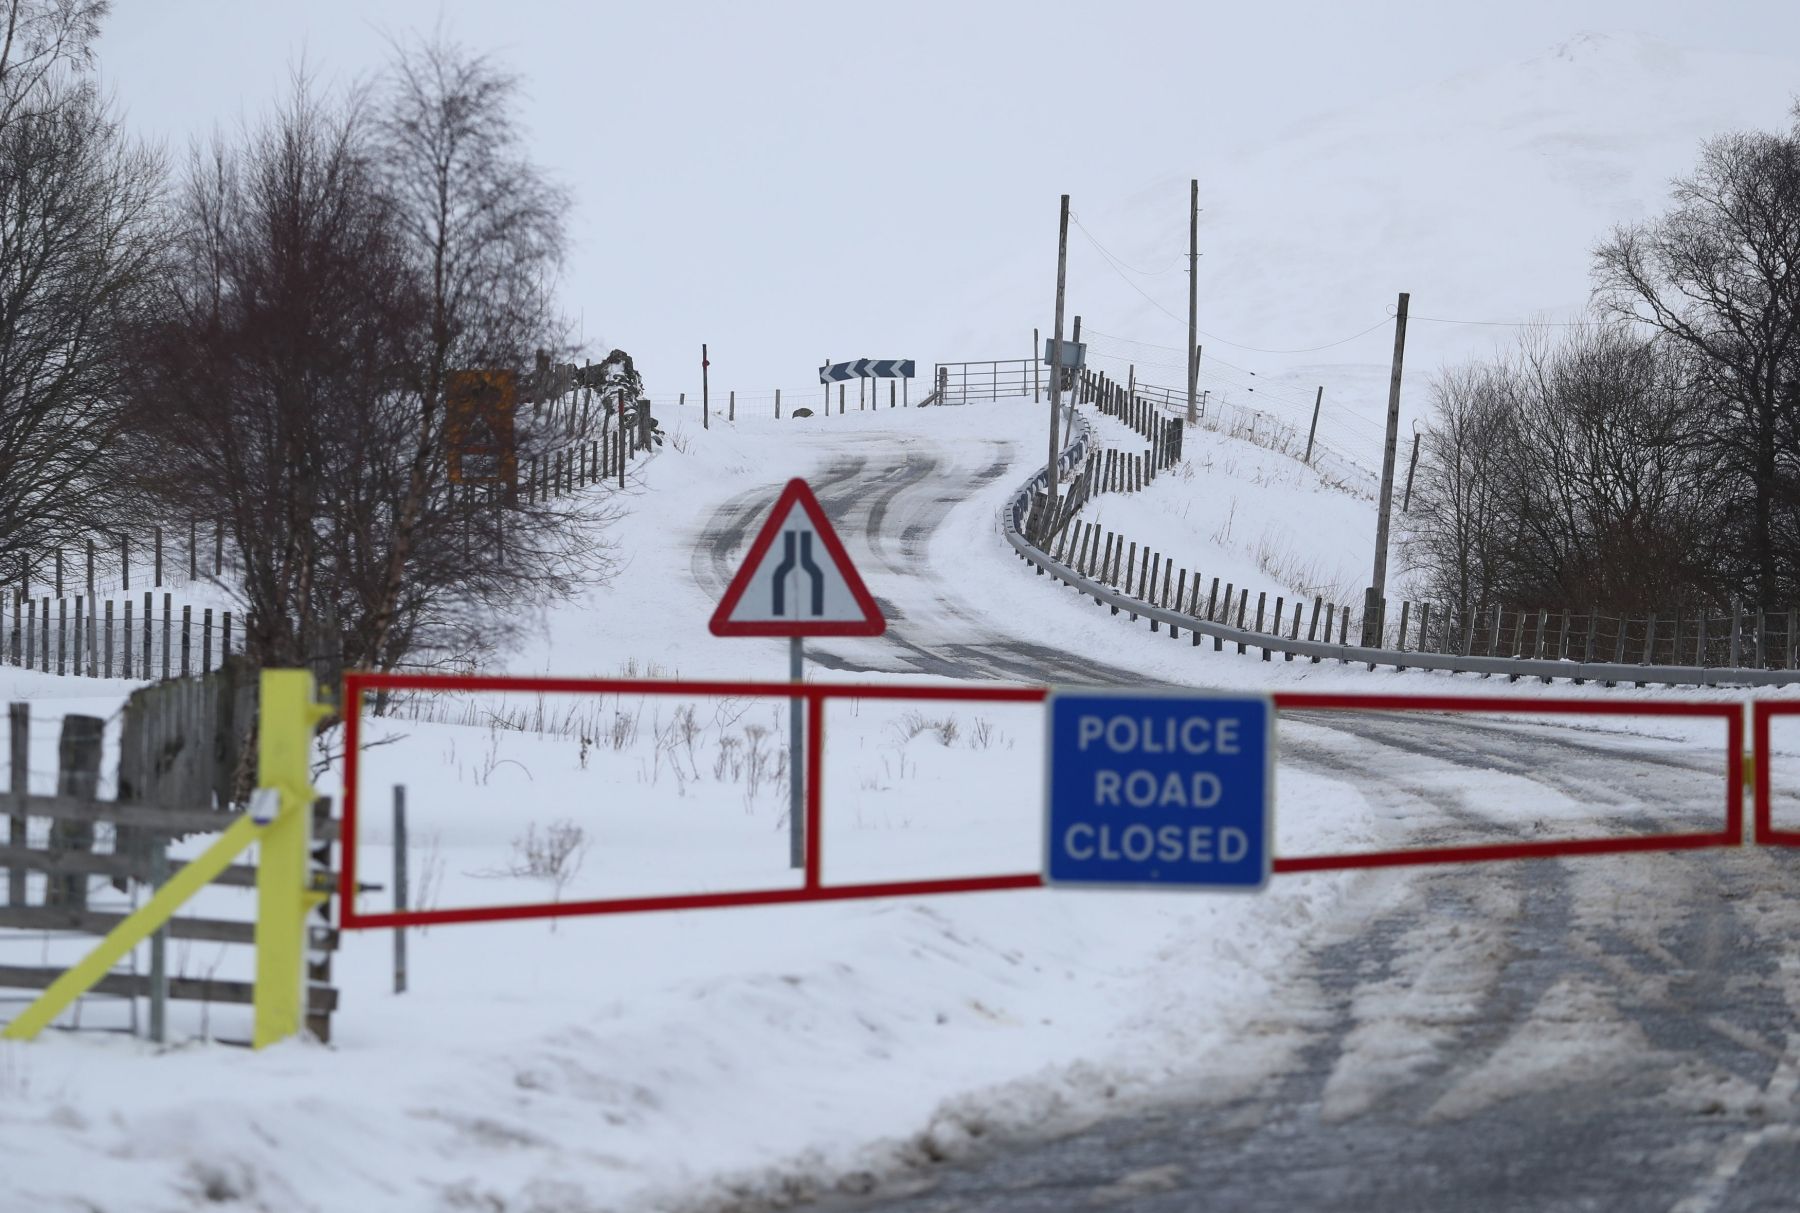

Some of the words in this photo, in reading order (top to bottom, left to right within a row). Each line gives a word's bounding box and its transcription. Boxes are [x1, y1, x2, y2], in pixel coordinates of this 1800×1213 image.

[1078, 715, 1240, 754] POLICE
[1095, 770, 1222, 808] ROAD
[1064, 822, 1249, 863] CLOSED
